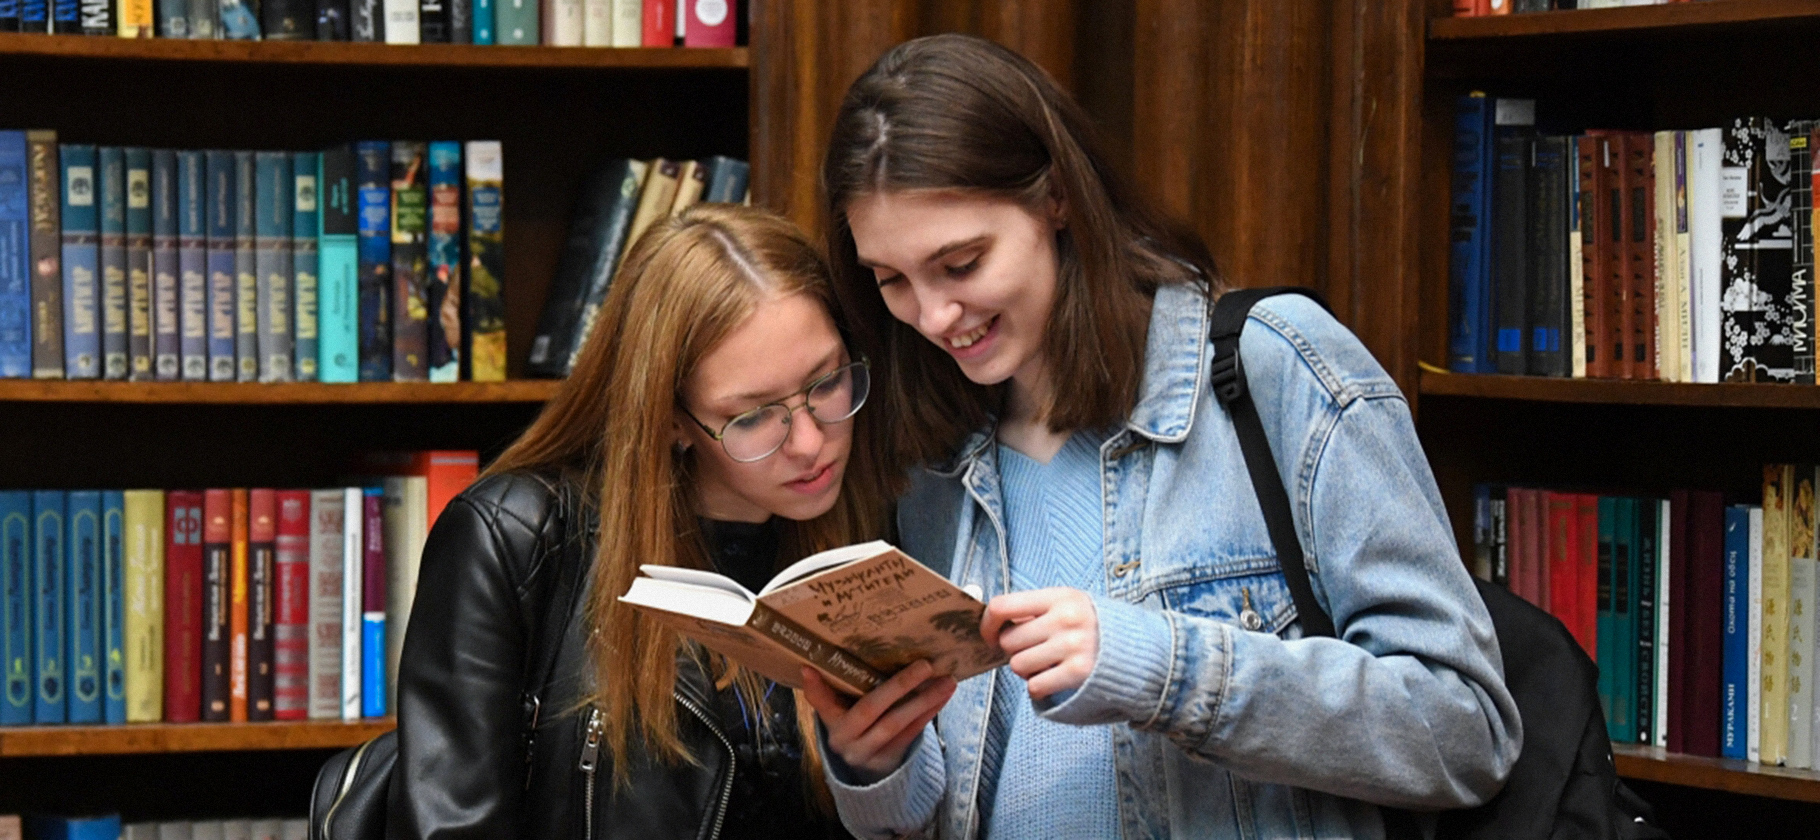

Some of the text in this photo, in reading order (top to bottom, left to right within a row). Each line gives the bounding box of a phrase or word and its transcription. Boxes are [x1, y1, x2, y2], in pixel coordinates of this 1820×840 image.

[1792, 269, 1807, 352] МИСИМА
[1728, 580, 1736, 594] на
[1728, 596, 1736, 634] Охота
[1727, 684, 1735, 748] МУРАКАМИ
